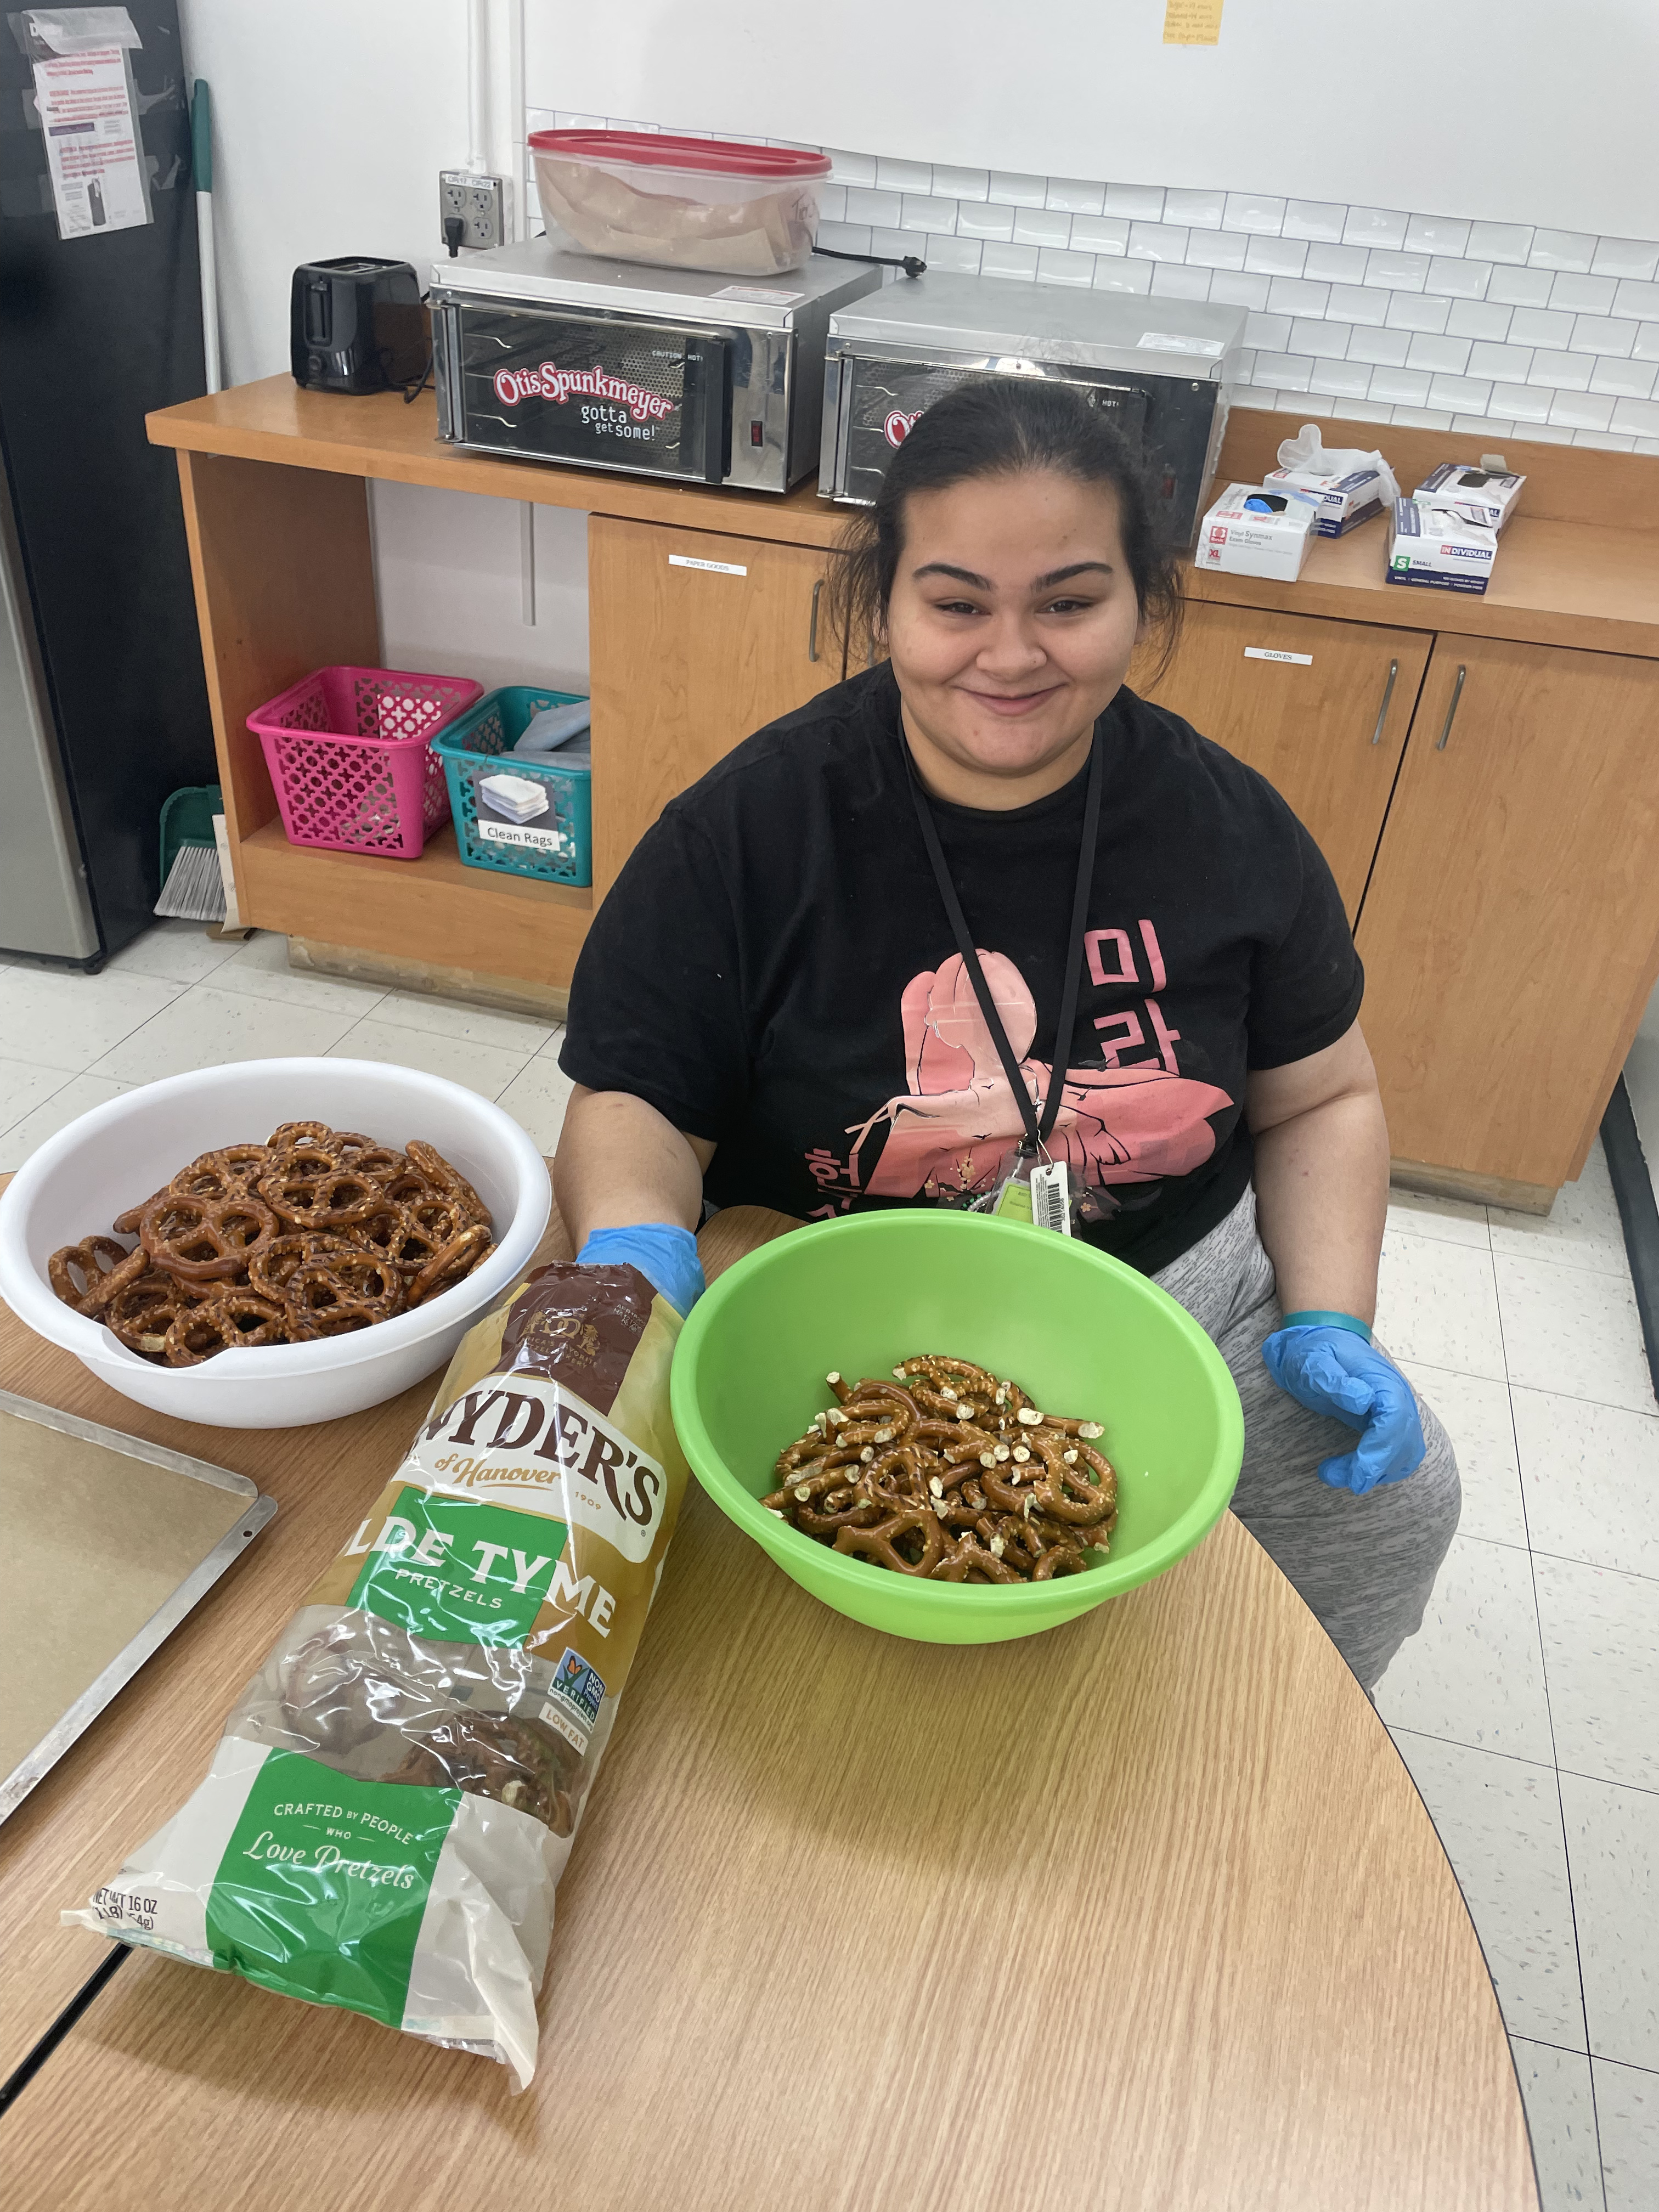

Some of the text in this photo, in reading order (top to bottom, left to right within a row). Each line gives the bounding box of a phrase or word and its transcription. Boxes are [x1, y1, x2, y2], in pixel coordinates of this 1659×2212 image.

[495, 364, 672, 421] Otis Spunkmeyer
[580, 405, 627, 424] gotta
[595, 422, 656, 441] get some!
[1209, 549, 1221, 558] XL
[1397, 557, 1408, 569] S
[1441, 546, 1491, 559] INDIVIDUAL
[1264, 651, 1293, 661] GLOVES
[487, 827, 553, 847] Clean Rags
[434, 1453, 562, 1487] of Hanover
[574, 1491, 602, 1511] 1909
[394, 1568, 503, 1609] PRETZELS
[469, 1539, 616, 1639] TYME
[586, 1681, 601, 1703] GMO
[589, 1672, 604, 1695] NON
[556, 1680, 595, 1720] VERIFIED
[545, 1709, 585, 1748] LOW FAT
[274, 1803, 414, 1845] CRAFTED BY PEOPLE
[325, 1826, 352, 1839] WHO
[242, 1831, 414, 1889] Love Pretzels
[128, 1895, 141, 1912] 16
[143, 1898, 158, 1915] OZ
